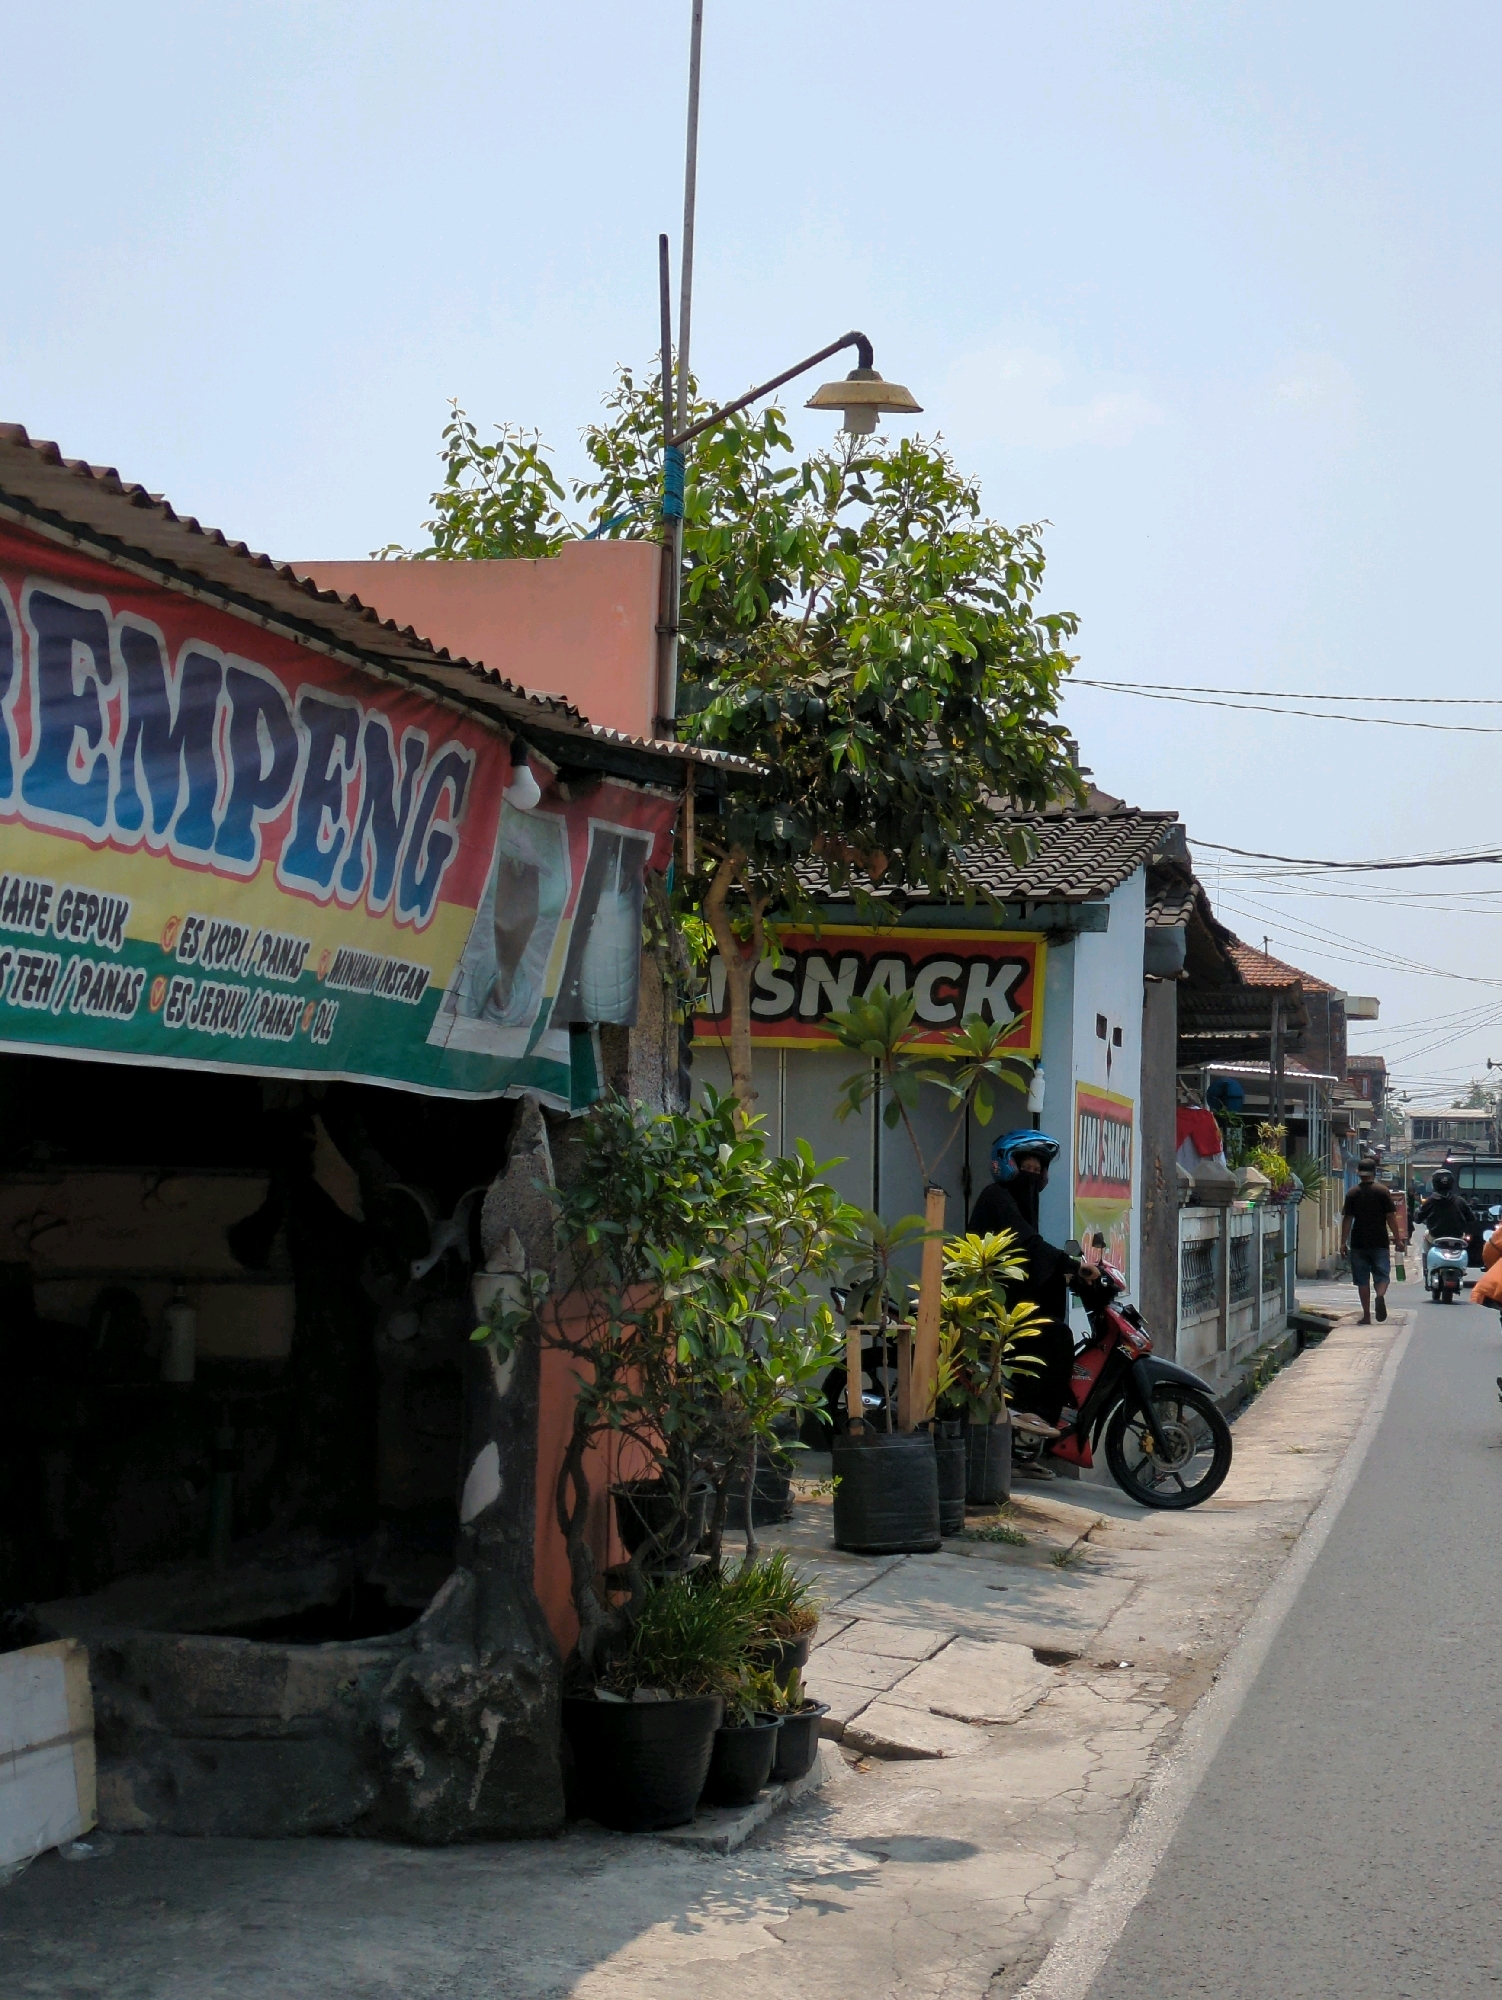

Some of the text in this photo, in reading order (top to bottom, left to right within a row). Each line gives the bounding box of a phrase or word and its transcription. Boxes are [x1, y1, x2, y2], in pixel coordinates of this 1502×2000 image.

[56, 888, 130, 947] GEPUK
[179, 916, 206, 960] ES
[202, 921, 249, 966] KOPI
[258, 933, 311, 979] PANAS
[10, 954, 59, 1004] TEH
[72, 964, 145, 1015] PANAS
[327, 949, 431, 1001] MINUMAN INSTAN
[750, 953, 1024, 1026] SNACK
[166, 978, 194, 1024] ES
[189, 982, 248, 1031] JERUK
[253, 996, 303, 1037] PANAS
[312, 1003, 334, 1040] DLL
[1078, 1114, 1132, 1181] UMI SNACK
